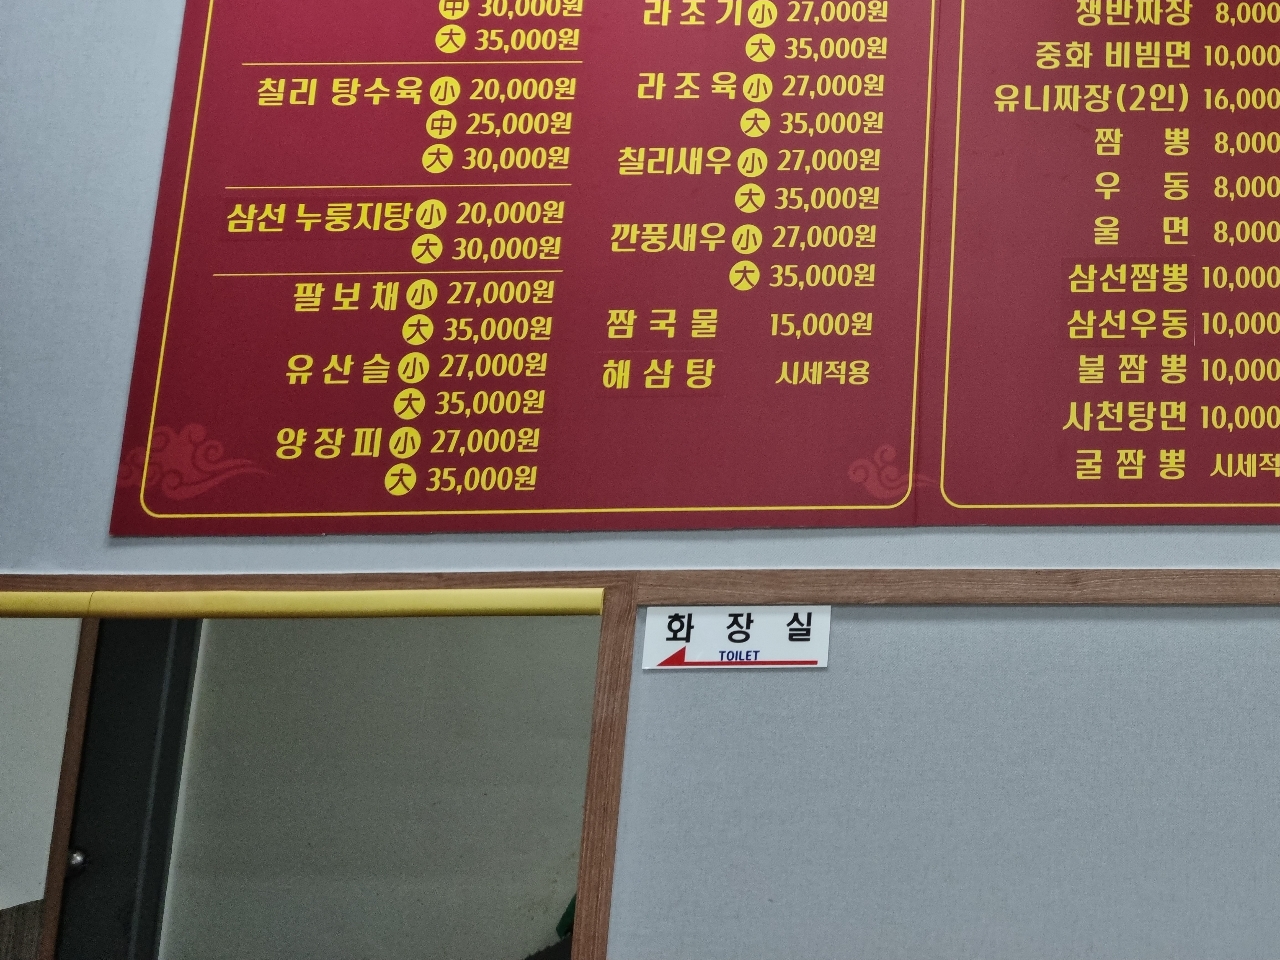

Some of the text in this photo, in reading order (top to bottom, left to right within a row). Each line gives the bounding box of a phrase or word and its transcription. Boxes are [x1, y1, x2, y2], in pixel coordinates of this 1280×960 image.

[786, 0, 889, 26] 27,000원
[474, 27, 580, 54] 35,000원
[784, 36, 888, 63] 35,000원
[1035, 40, 1094, 70] 중화
[1105, 40, 1191, 69] 비빔면
[257, 76, 577, 107] 칠리 탕수육 20,000원
[781, 73, 885, 100] 27,000원
[993, 83, 1189, 113] 유니짜장(2인)
[465, 111, 573, 138] 25,000원
[779, 110, 884, 138] 35,000원
[461, 145, 571, 173] 30,000원
[617, 146, 881, 177] 칠리새우 27,000원
[774, 186, 880, 213] 35,000원
[226, 200, 566, 233] 삼선 누룽지탕 20,000원
[451, 235, 562, 264] 30,000원
[610, 222, 877, 253] 깐풍새우 27,000원
[769, 263, 876, 291] 35,000원
[1068, 263, 1189, 293] 삼선짬뽕
[446, 279, 555, 308] 27,000원
[442, 315, 553, 345] 35,000원
[770, 311, 873, 340] 15,000원
[1066, 308, 1188, 339] 삼선우동
[438, 352, 548, 381] 27,000원
[775, 359, 870, 386] 시세적용
[434, 389, 546, 419] 35,000원
[1062, 400, 1187, 432] 사천탕면
[429, 427, 541, 457] 27,000원
[425, 465, 538, 496] 35,000원
[718, 650, 760, 662] TOILET
